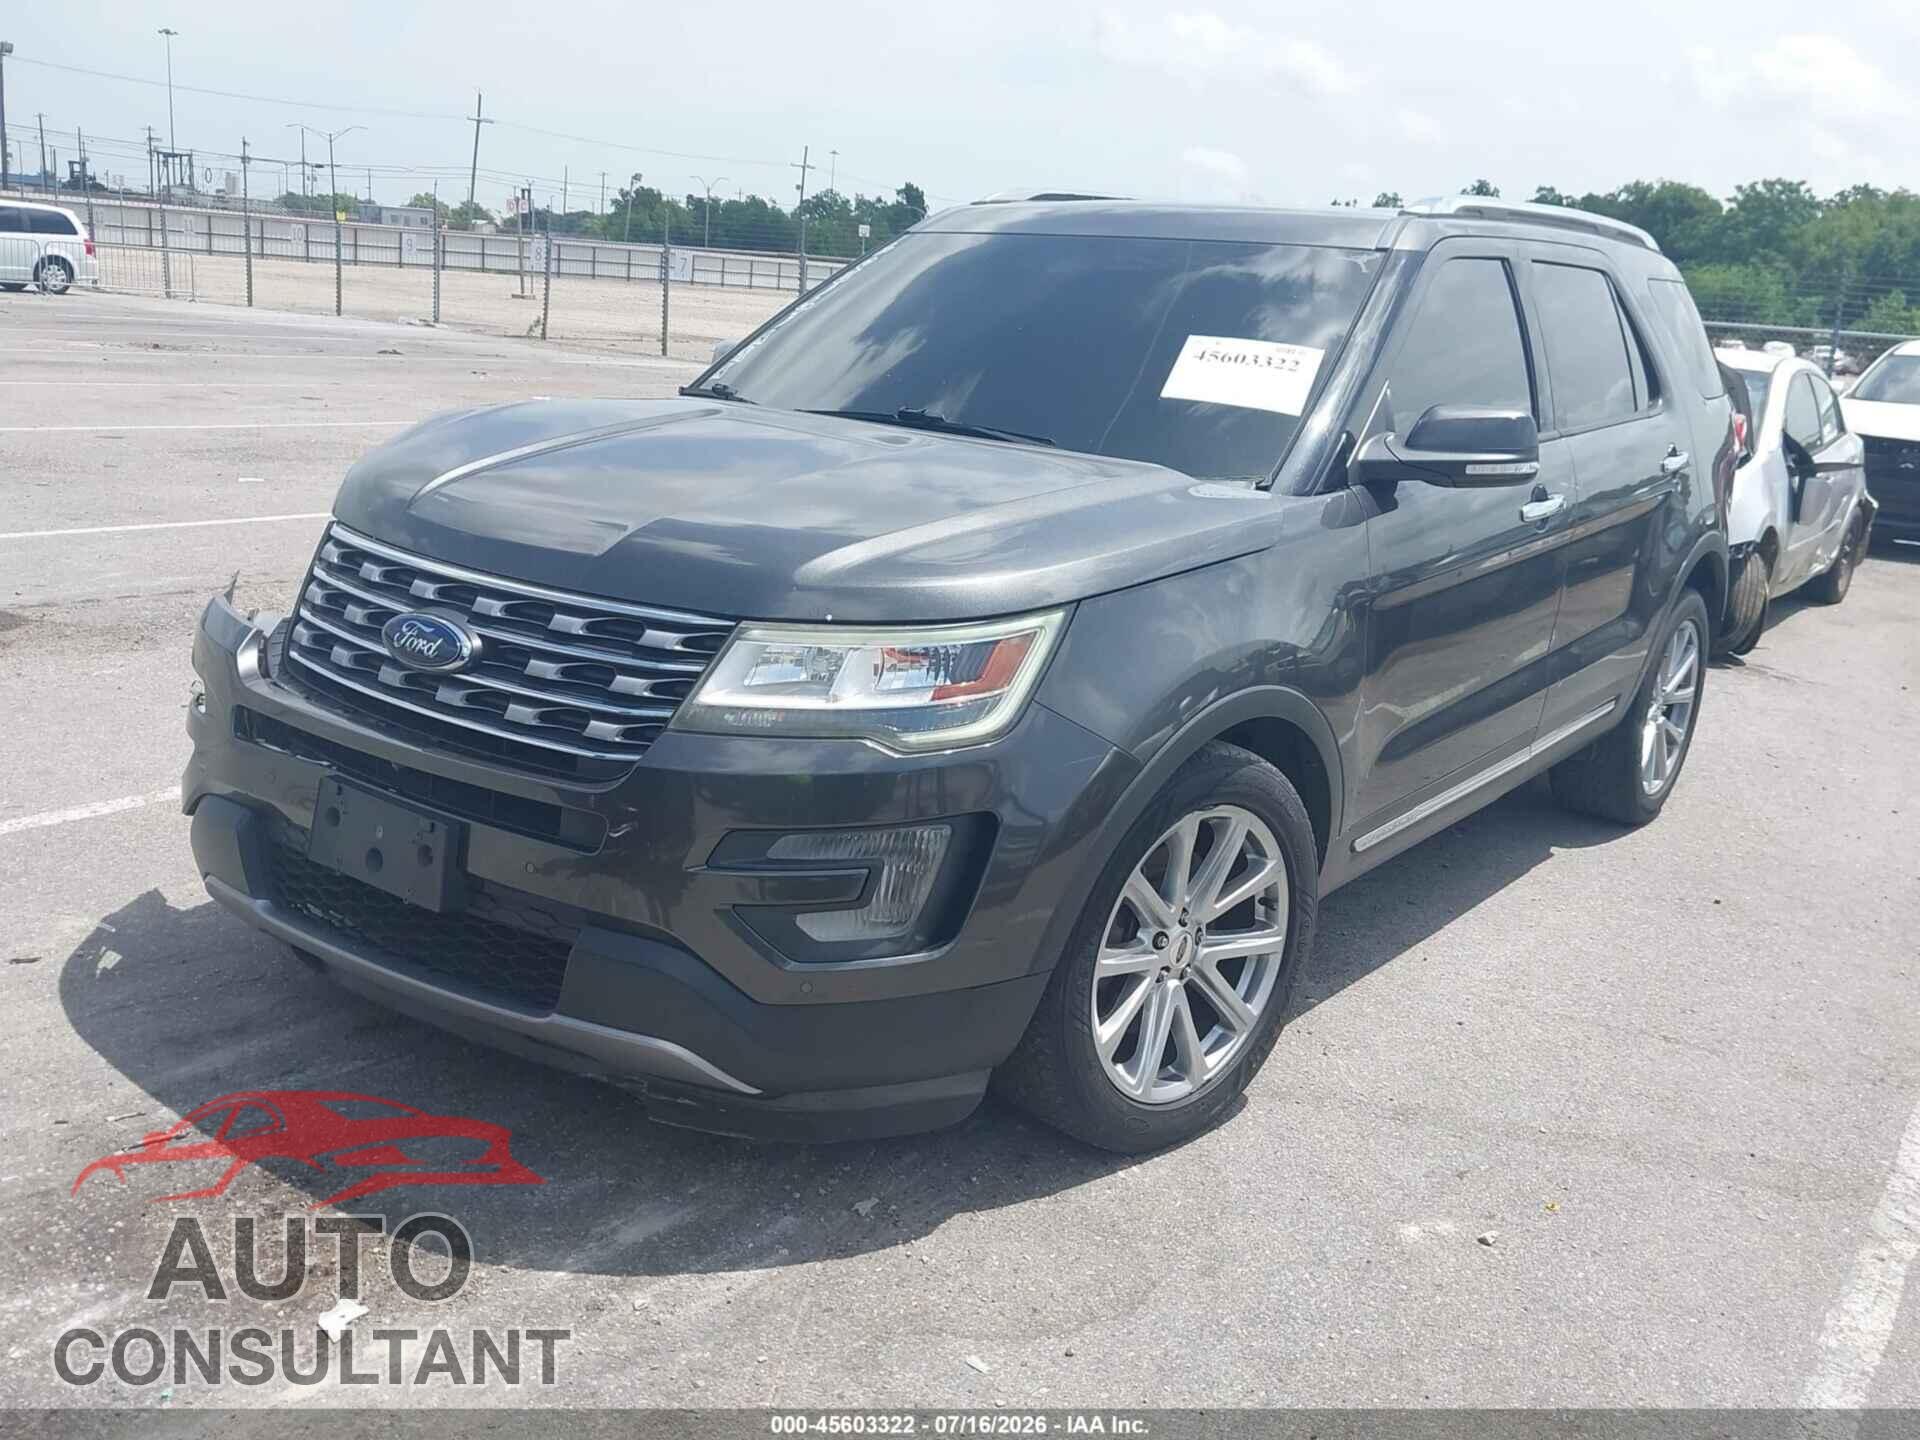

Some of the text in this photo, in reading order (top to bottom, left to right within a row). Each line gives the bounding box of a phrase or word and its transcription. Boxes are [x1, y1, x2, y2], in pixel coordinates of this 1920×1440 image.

[535, 246, 542, 261] 8
[680, 257, 688, 272] 7
[1193, 350, 1301, 372] 45603322
[393, 620, 444, 658] Ford
